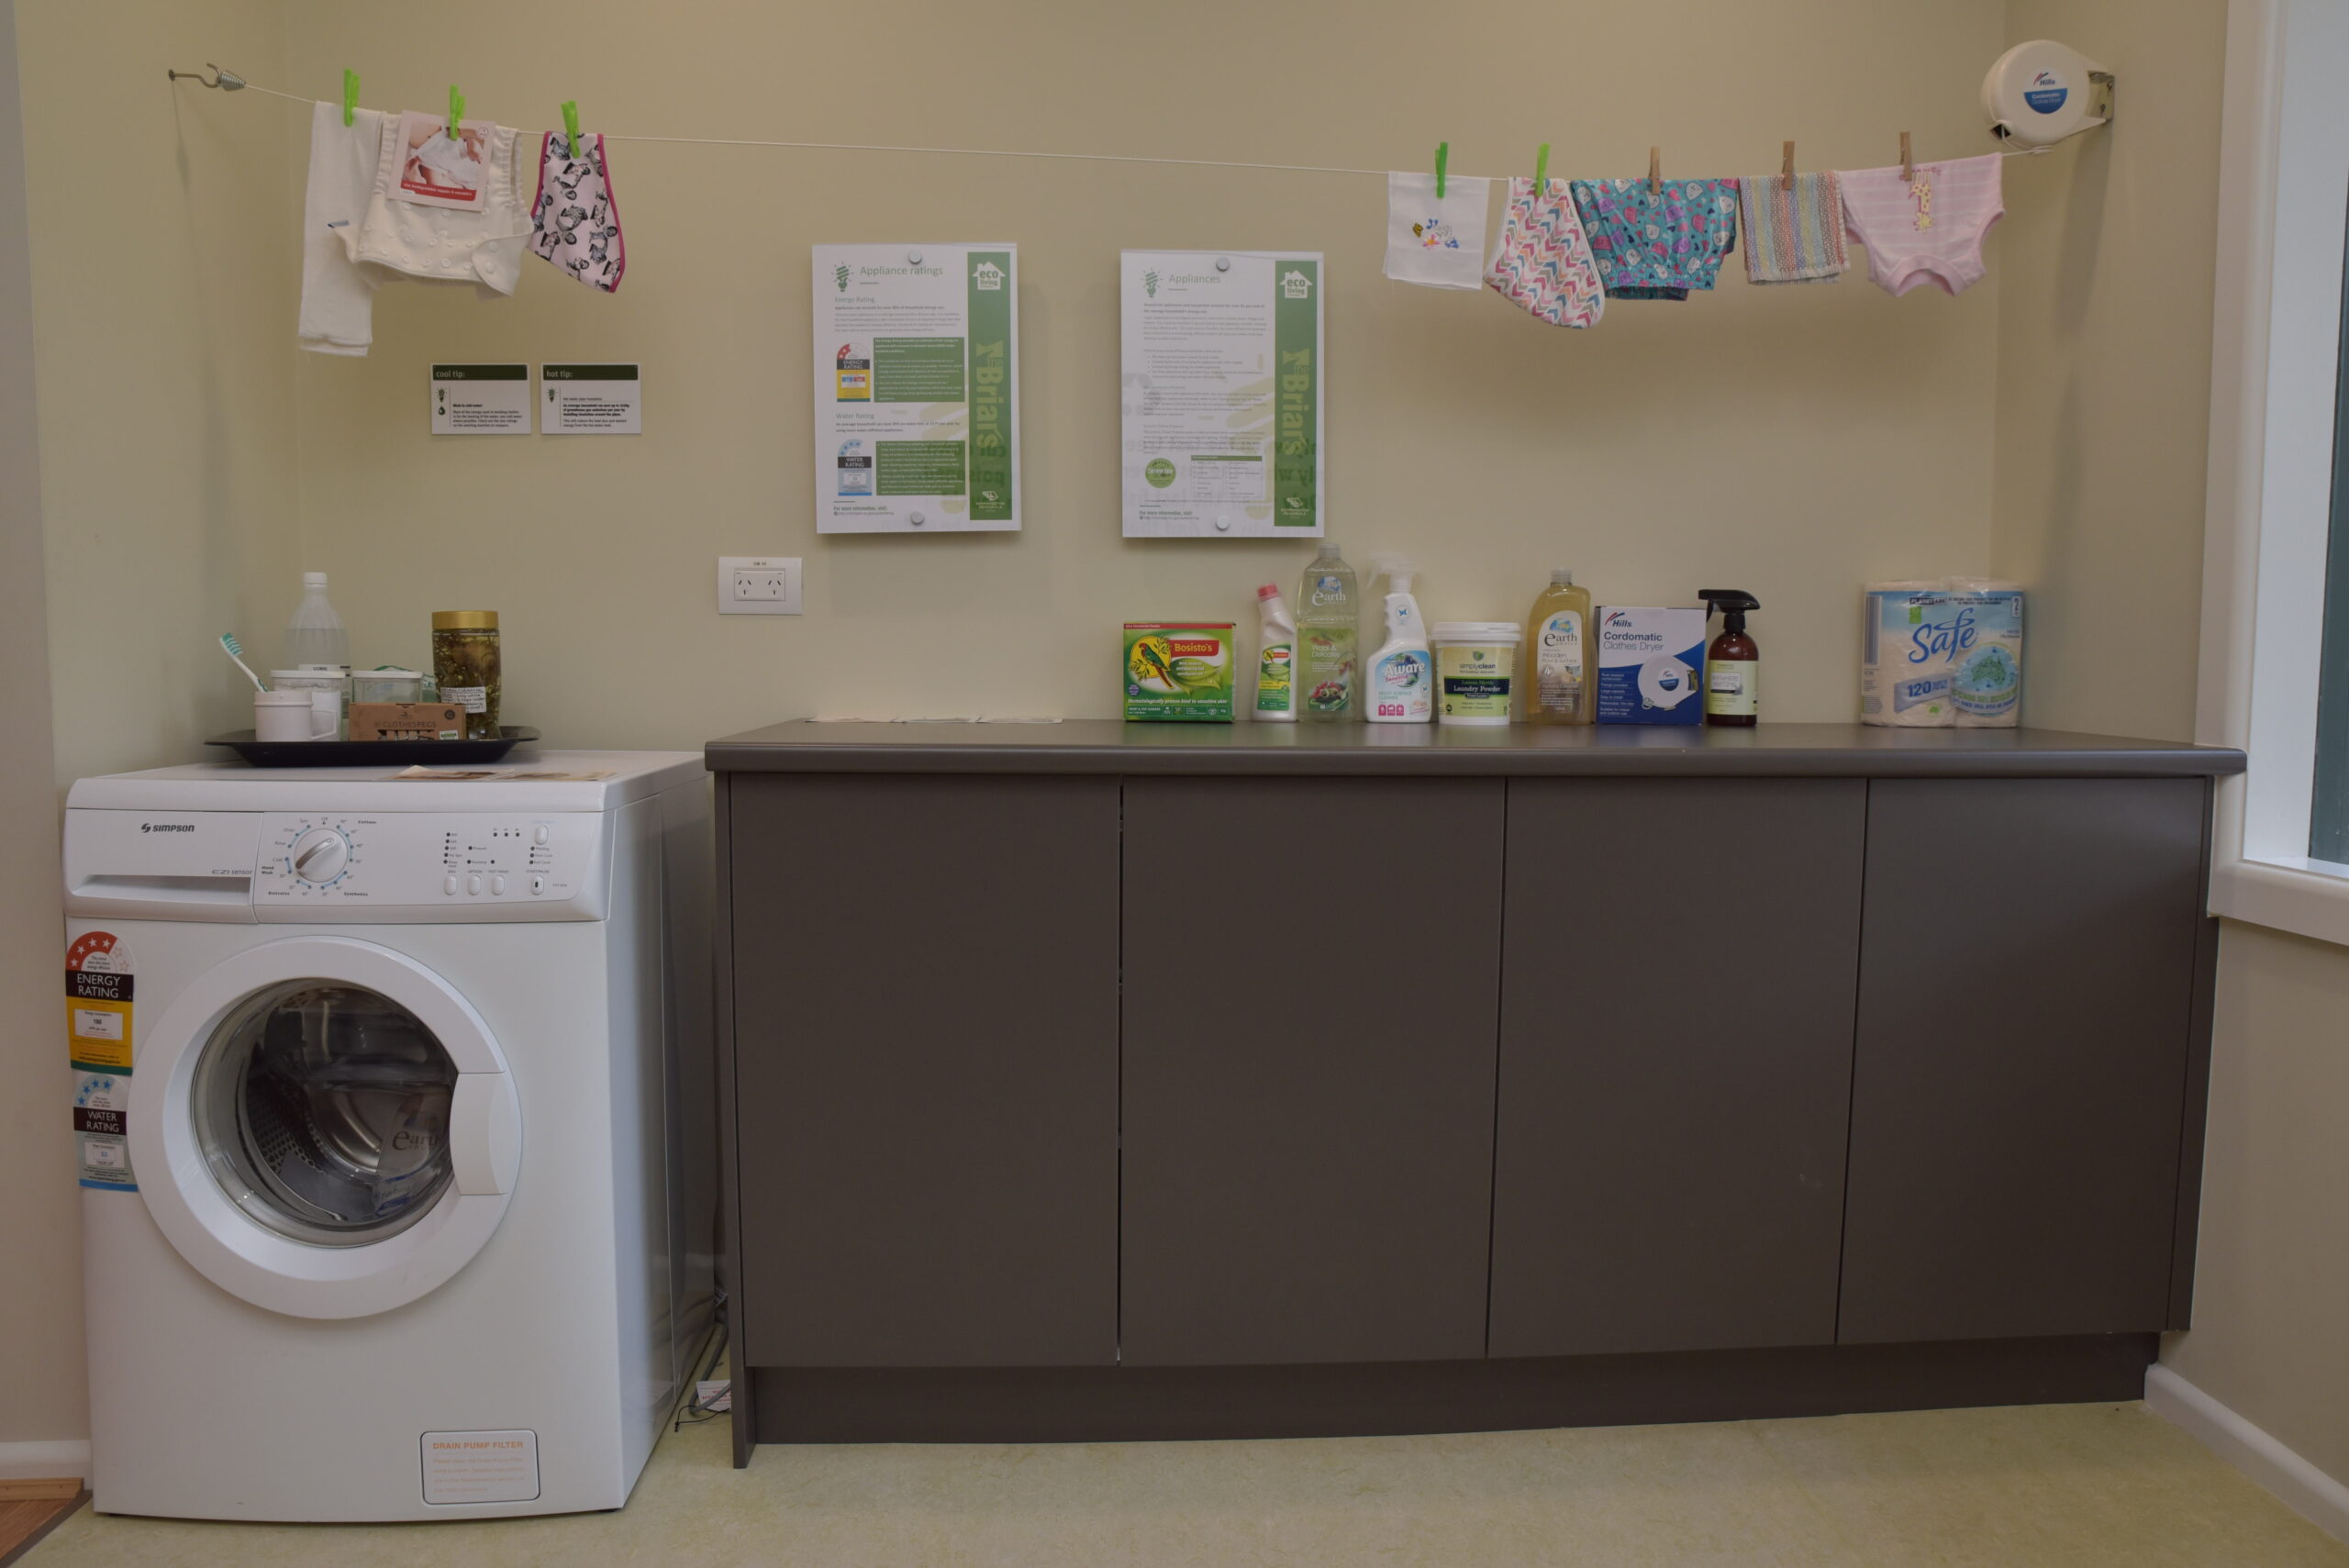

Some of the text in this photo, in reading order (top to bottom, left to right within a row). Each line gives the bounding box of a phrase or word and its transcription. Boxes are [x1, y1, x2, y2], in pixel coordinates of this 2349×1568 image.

[860, 265, 943, 276] Appliance ratings
[979, 270, 999, 278] eco
[980, 278, 998, 287] living
[1169, 274, 1220, 284] Appliances
[453, 370, 465, 379] tip:
[560, 370, 573, 379] tip:
[1312, 590, 1346, 606] earth
[1544, 633, 1577, 646] earth
[1604, 632, 1663, 642] Cordomatic
[1908, 607, 1977, 663] Safe
[1174, 644, 1212, 652] Bosisto's
[1603, 641, 1664, 652] Clothes Dryer
[1385, 662, 1425, 676] Aware
[1907, 680, 1932, 697] 120
[152, 824, 195, 833] SIMPSON
[77, 973, 121, 986] ENERGY
[78, 987, 119, 999] RATING
[88, 1111, 117, 1121] WATER
[86, 1121, 119, 1132] RATING
